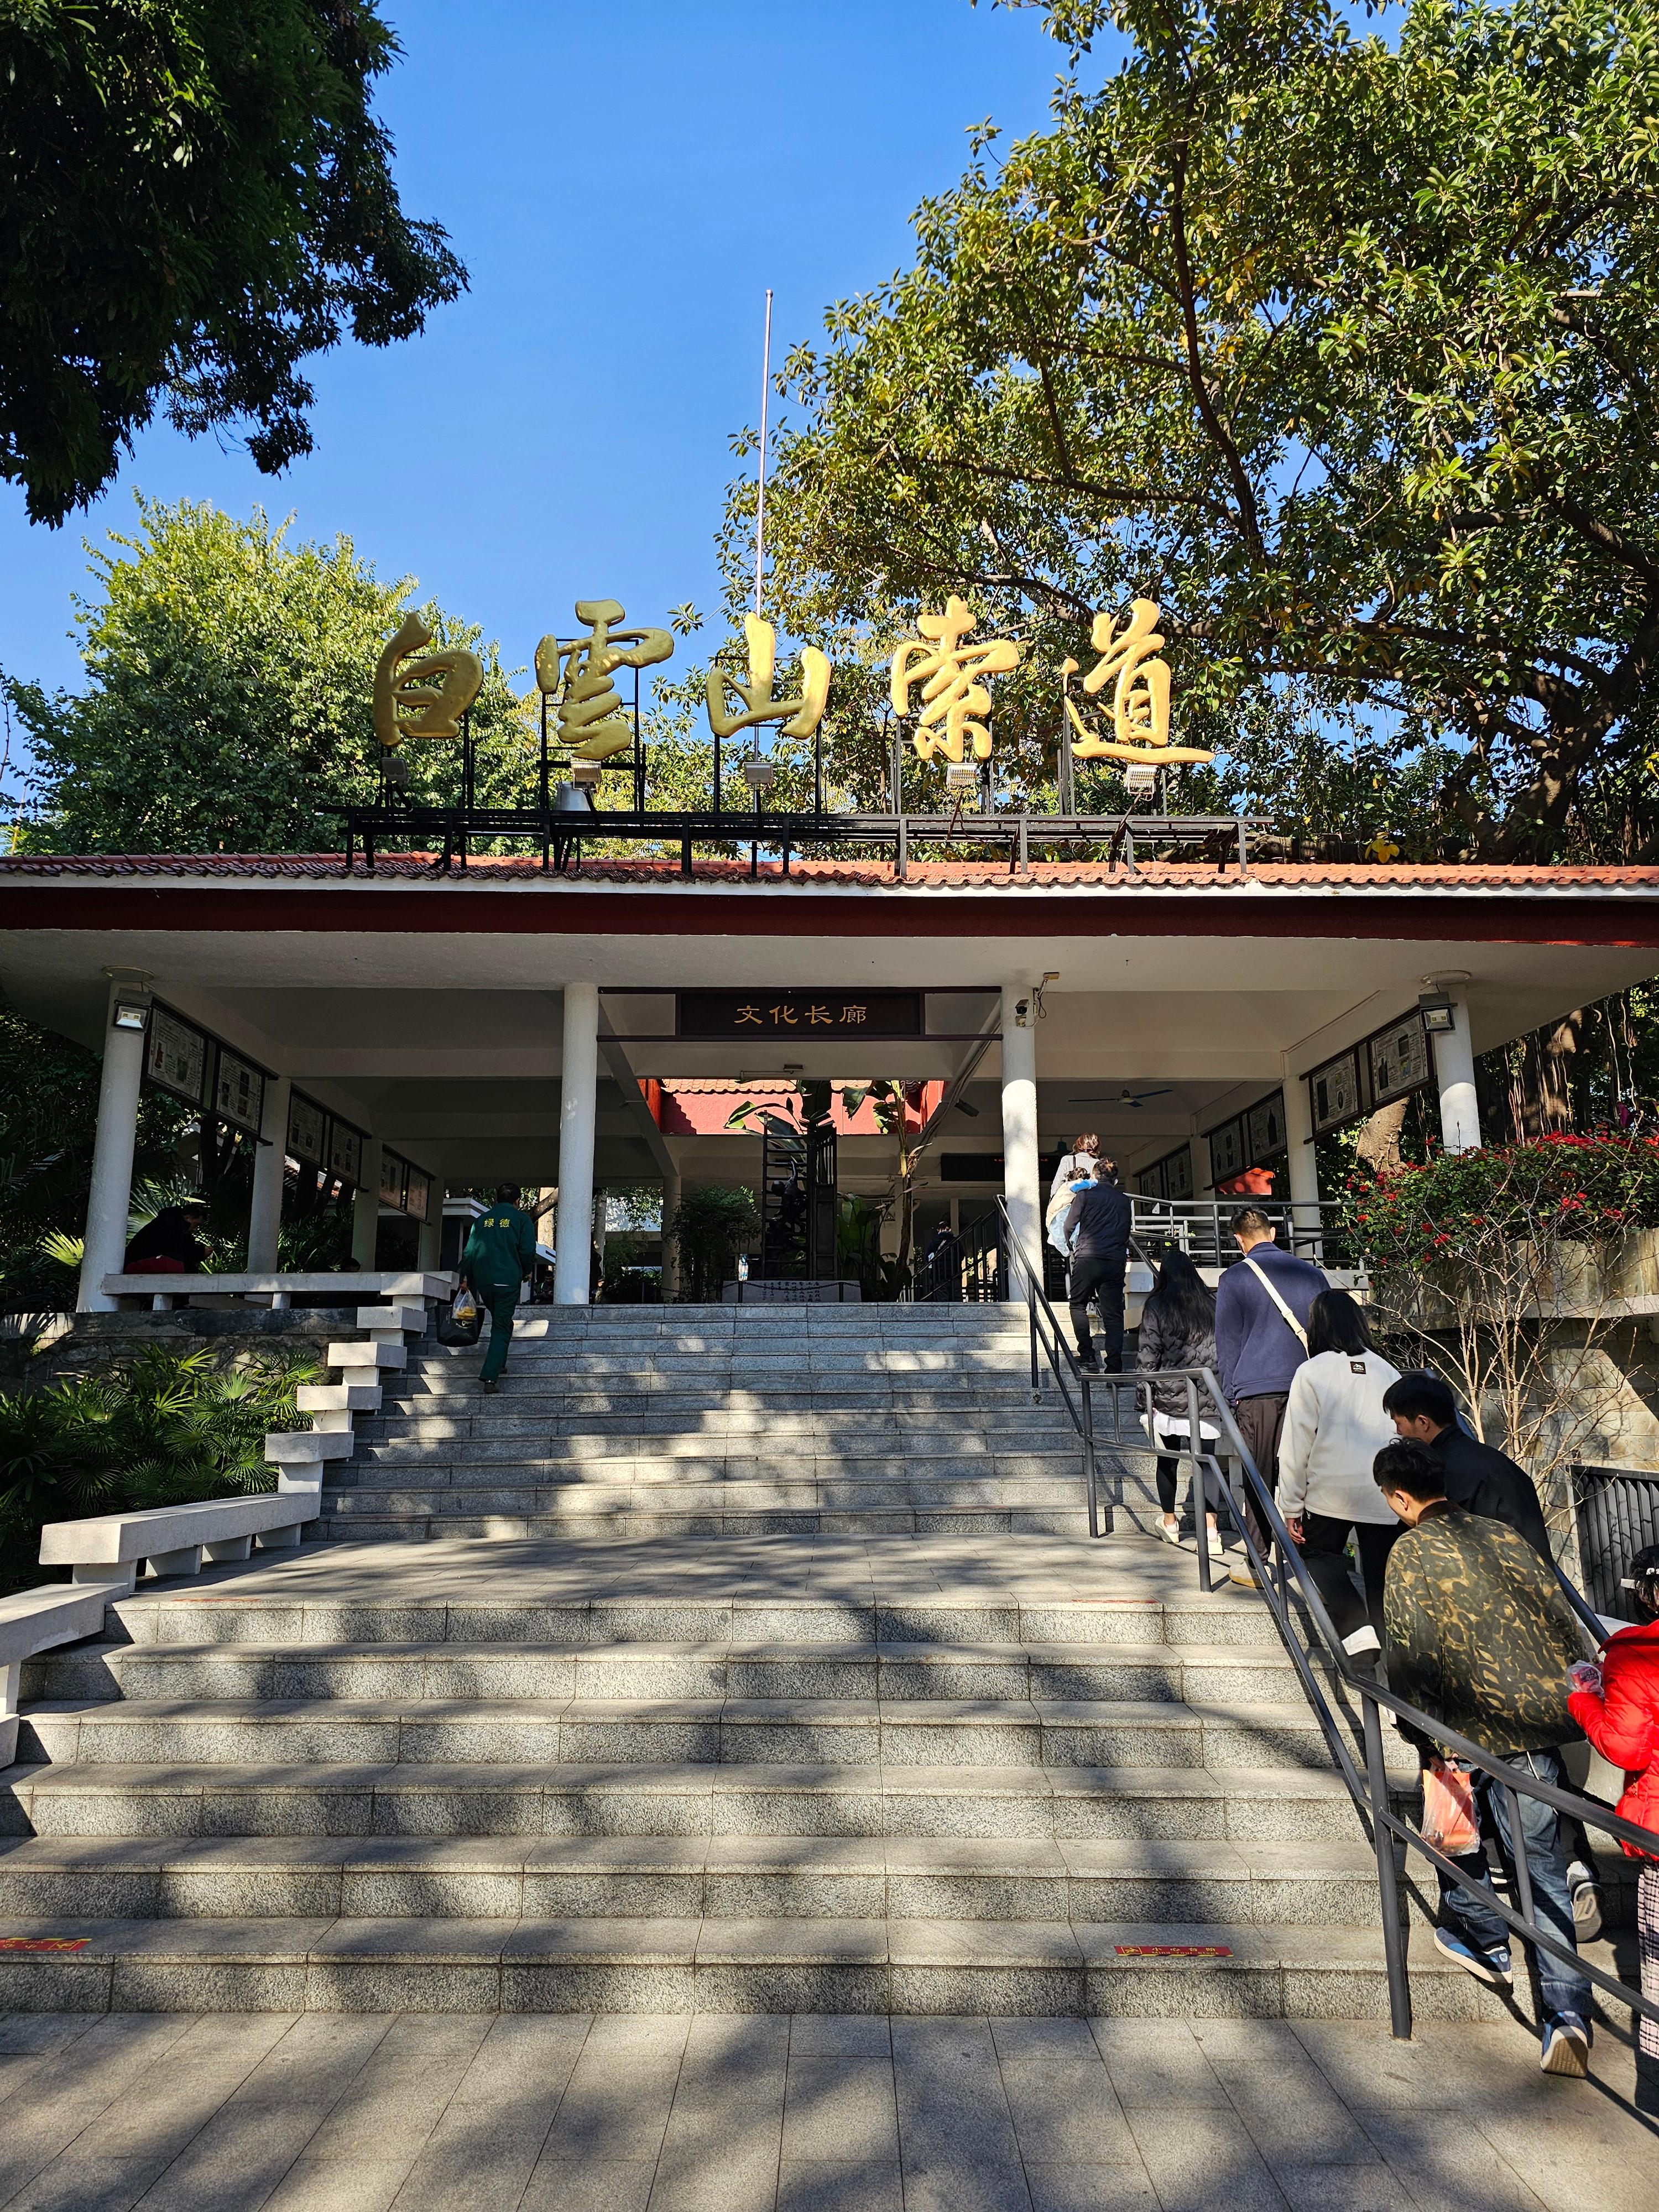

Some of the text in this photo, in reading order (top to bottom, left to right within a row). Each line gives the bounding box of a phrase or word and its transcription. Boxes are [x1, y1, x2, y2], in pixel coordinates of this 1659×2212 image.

[734, 1005, 867, 1024] 文化长廊
[484, 1218, 510, 1227] 绿德
